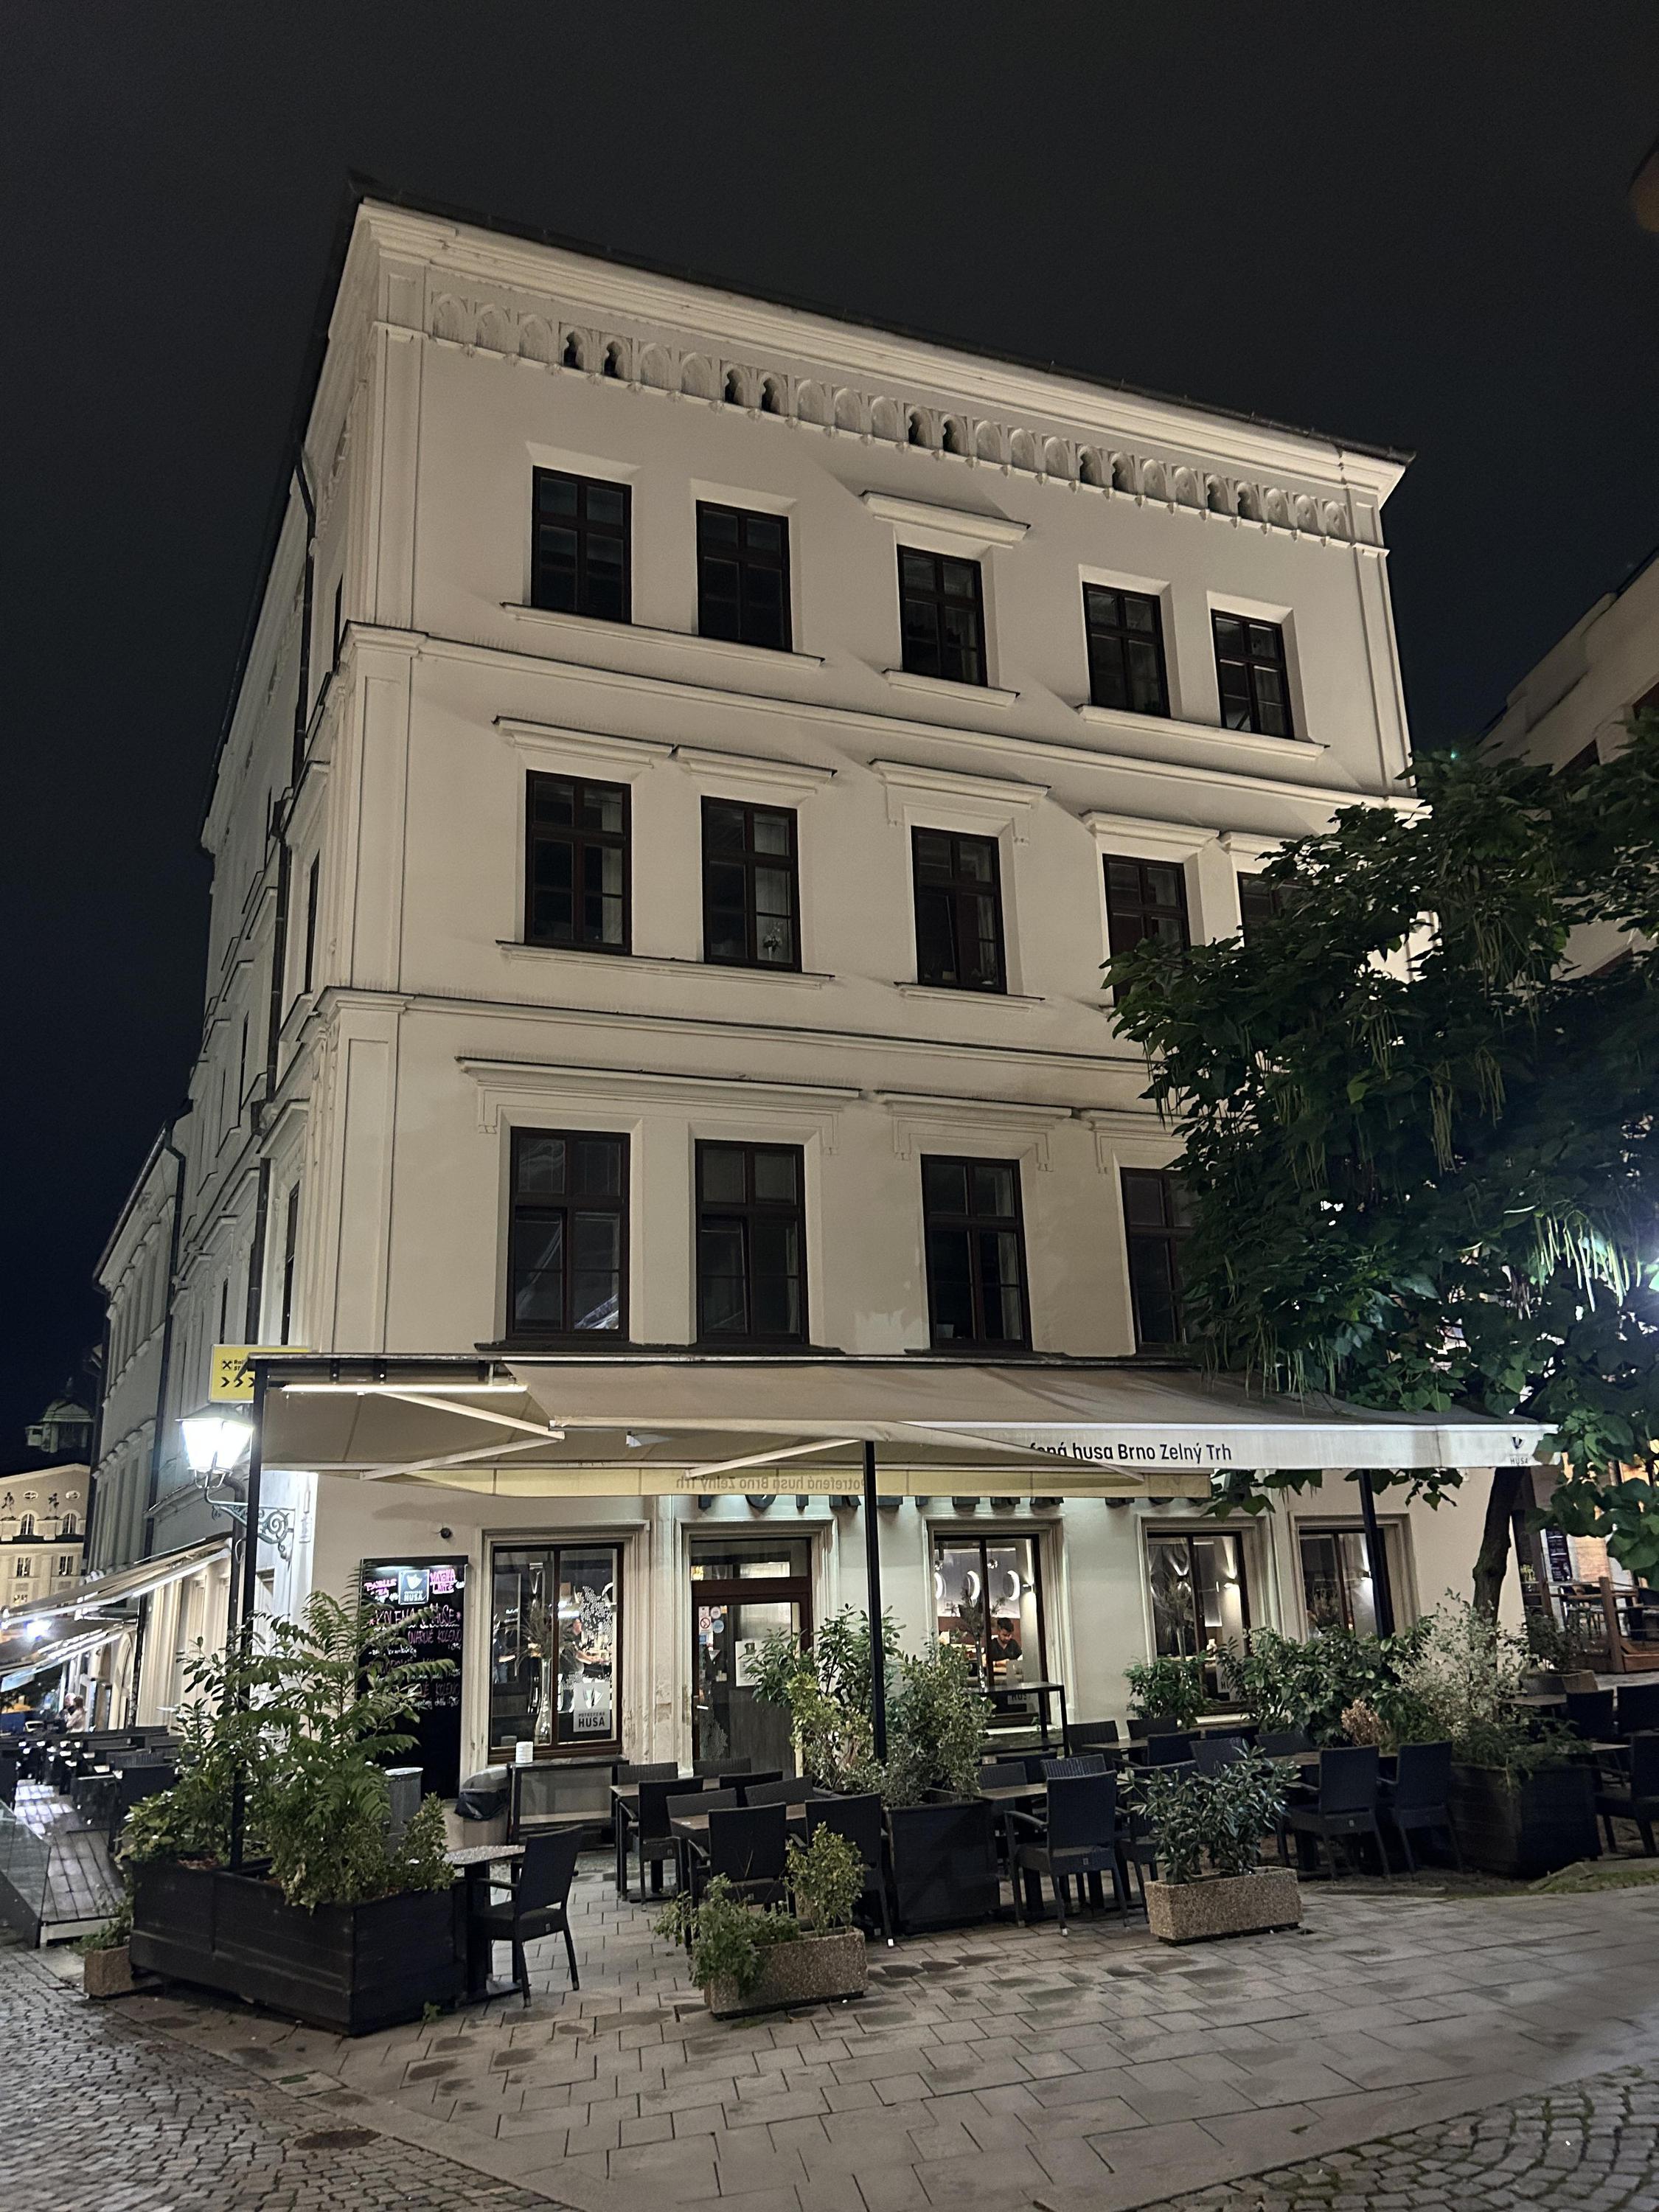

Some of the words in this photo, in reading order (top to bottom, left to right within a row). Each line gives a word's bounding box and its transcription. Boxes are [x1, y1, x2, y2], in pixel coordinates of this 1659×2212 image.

[1073, 1442, 1113, 1460] husa
[1118, 1443, 1155, 1460] Brno
[1161, 1442, 1202, 1464] Zelný
[1206, 1443, 1231, 1460] Trh
[1509, 1457, 1528, 1465] HUSA
[403, 1593, 423, 1602] HUSA
[578, 1717, 605, 1728] HUSA
